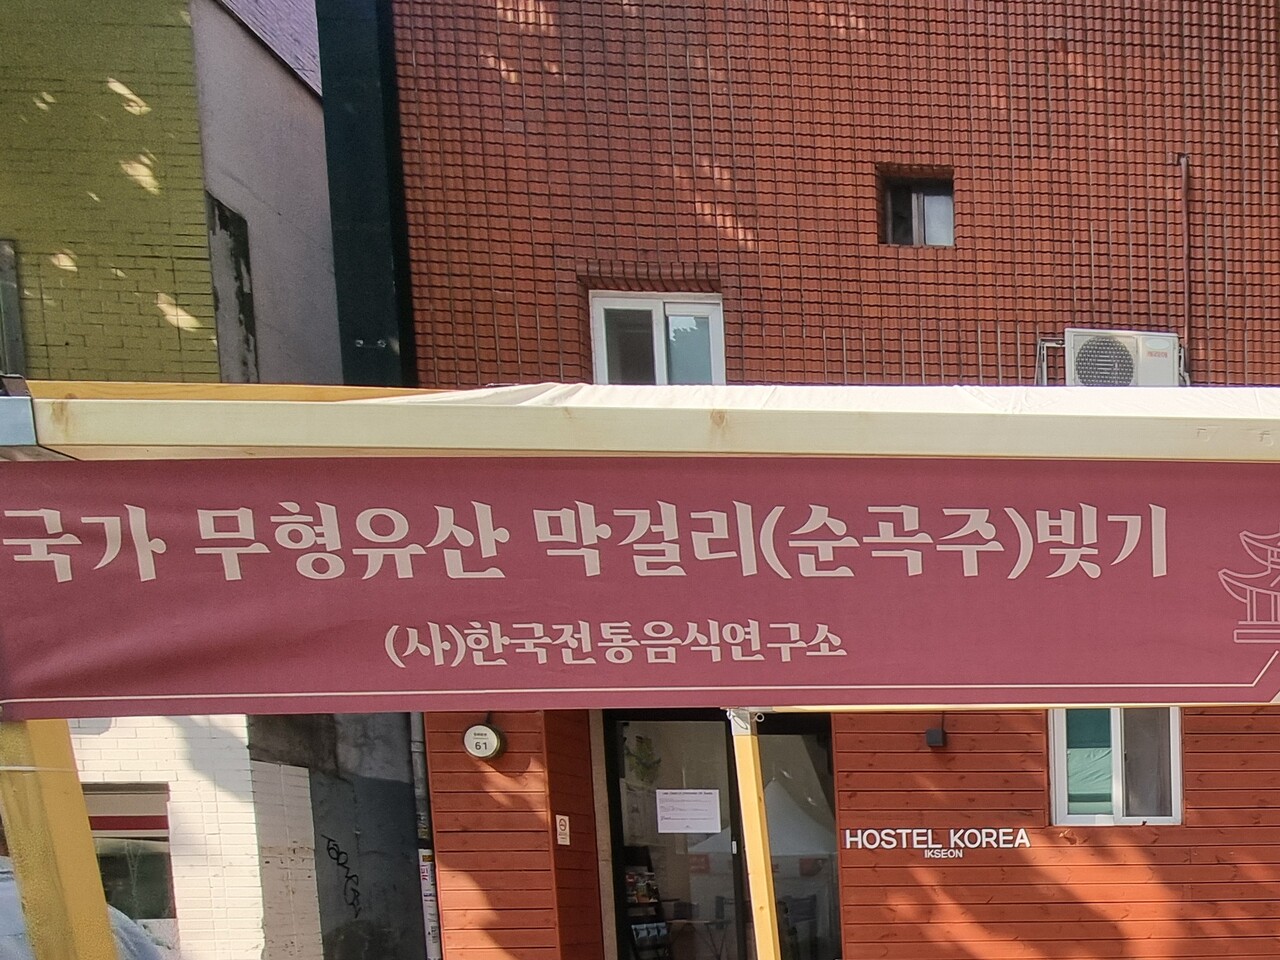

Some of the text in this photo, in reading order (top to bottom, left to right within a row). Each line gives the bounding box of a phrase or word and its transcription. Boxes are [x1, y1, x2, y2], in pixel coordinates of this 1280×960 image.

[2, 500, 1168, 583] 국가 무형유산 막걸리(순곡주)빚기
[384, 620, 848, 668] (사)한국전통음식연구소
[474, 741, 488, 750] 61
[845, 828, 1031, 849] HOSTEL KOREA
[924, 849, 963, 858] IKSEON
